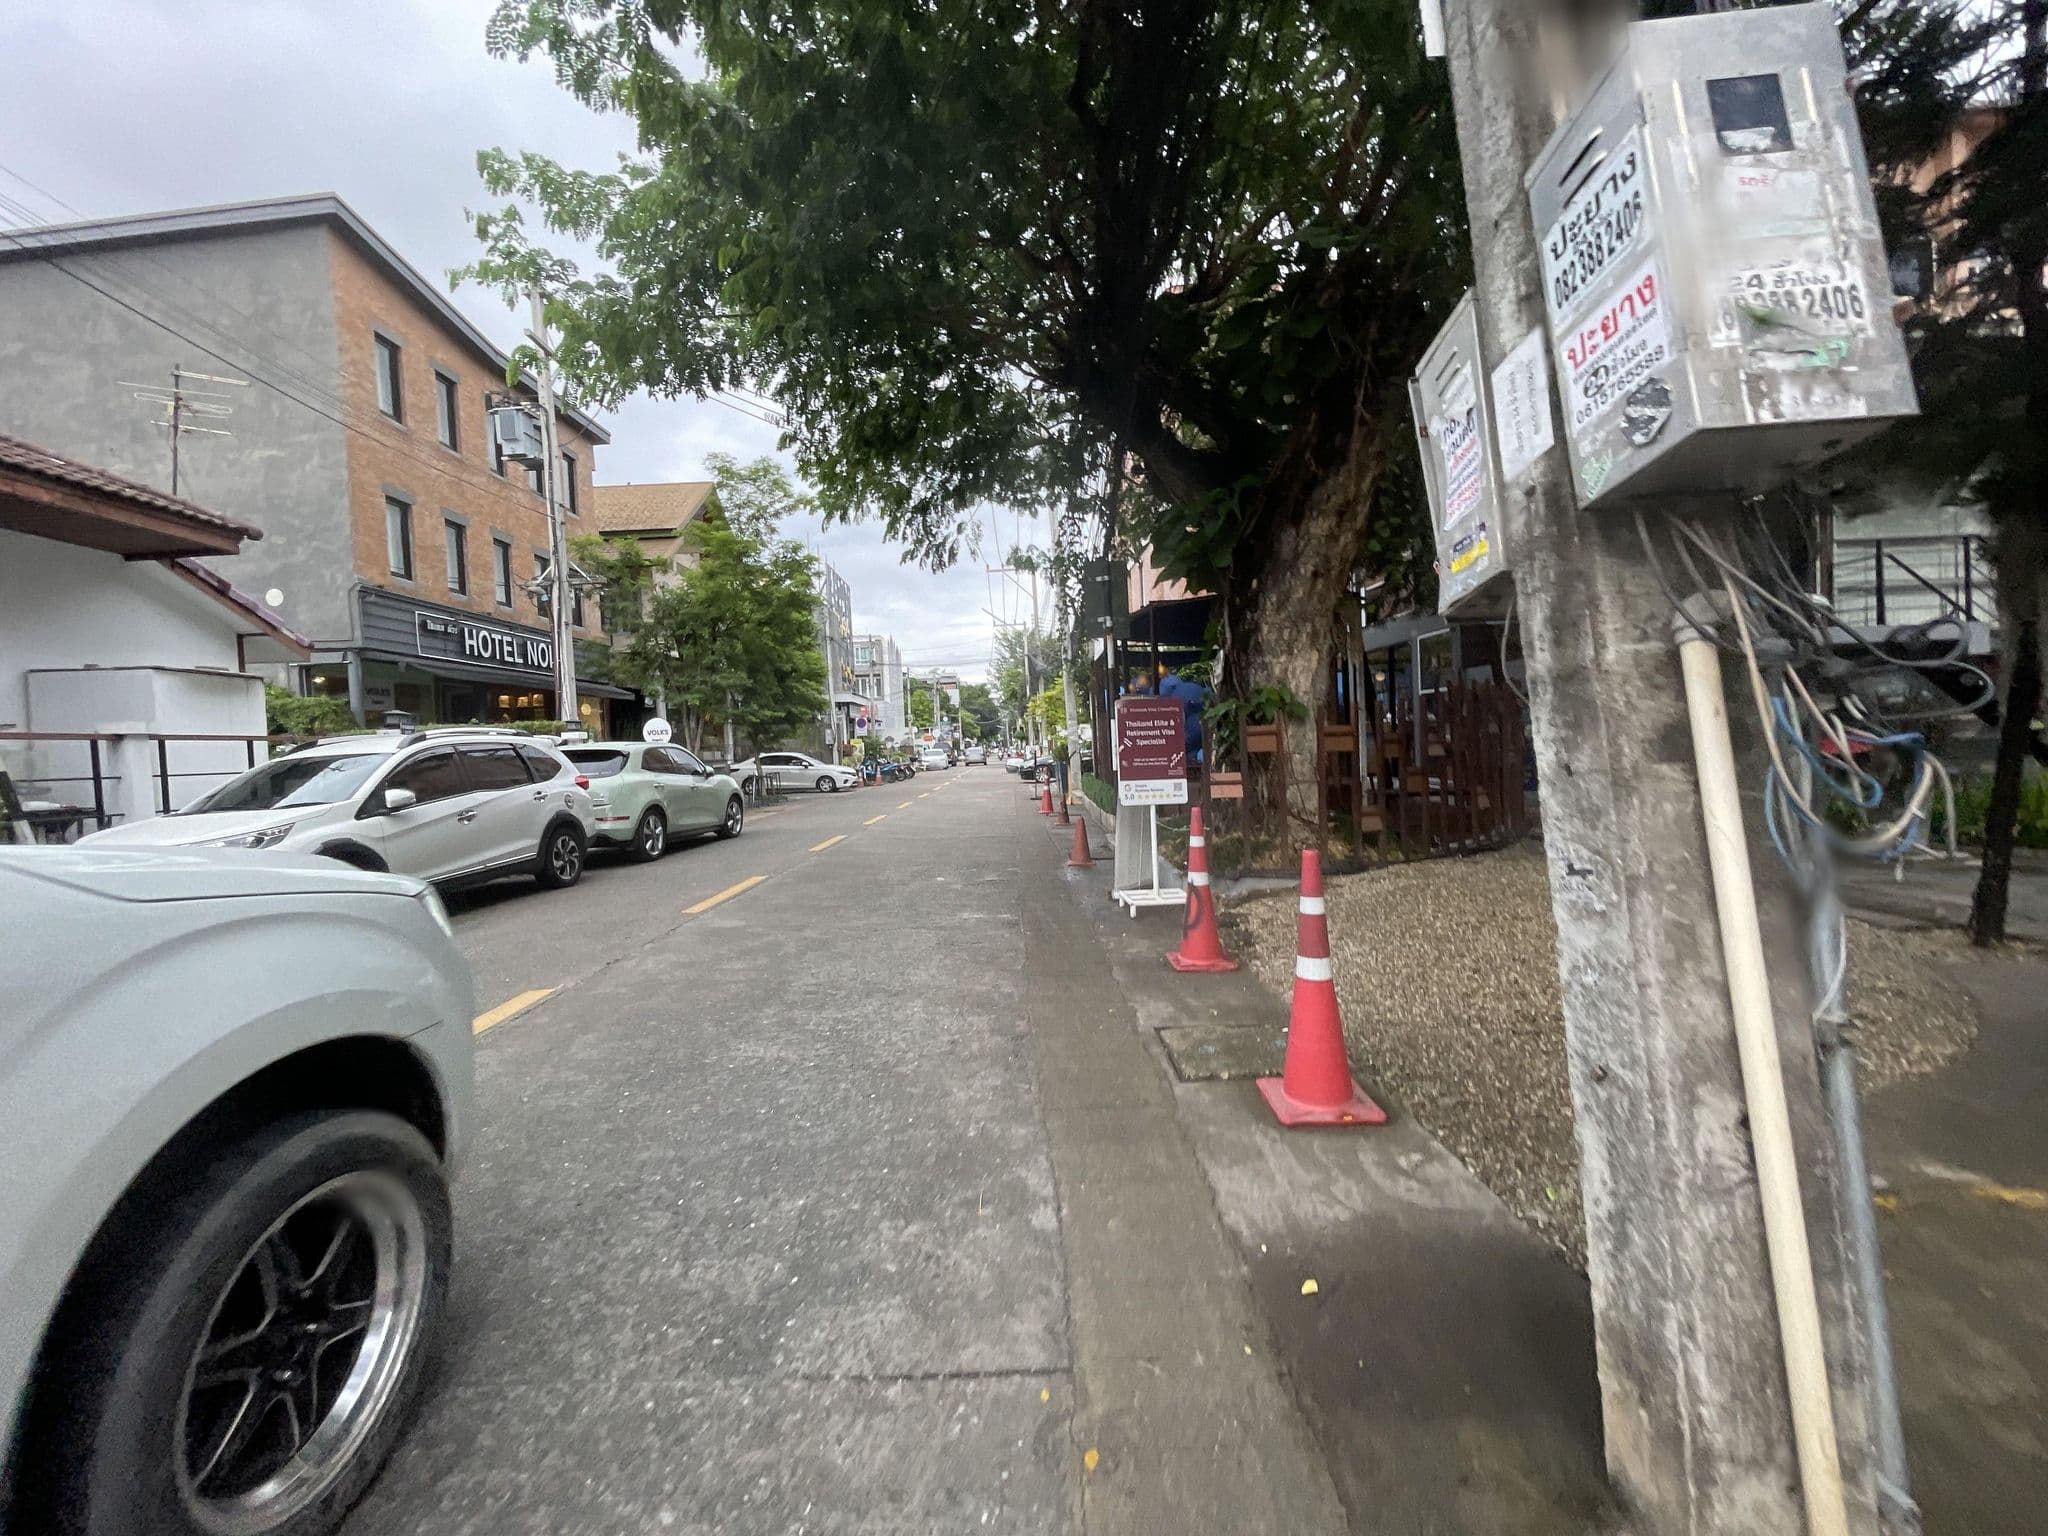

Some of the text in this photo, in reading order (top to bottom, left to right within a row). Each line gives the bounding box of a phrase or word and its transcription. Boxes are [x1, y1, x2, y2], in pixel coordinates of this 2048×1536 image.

[1550, 151, 1638, 260] ปะยาง
[1566, 274, 1656, 369] ปะยาง
[464, 627, 524, 663] HOTEL
[1125, 719, 1153, 727] Thailand
[1169, 718, 1175, 726] &
[1126, 729, 1160, 737] Retirement
[1136, 738, 1166, 747] Specialist
